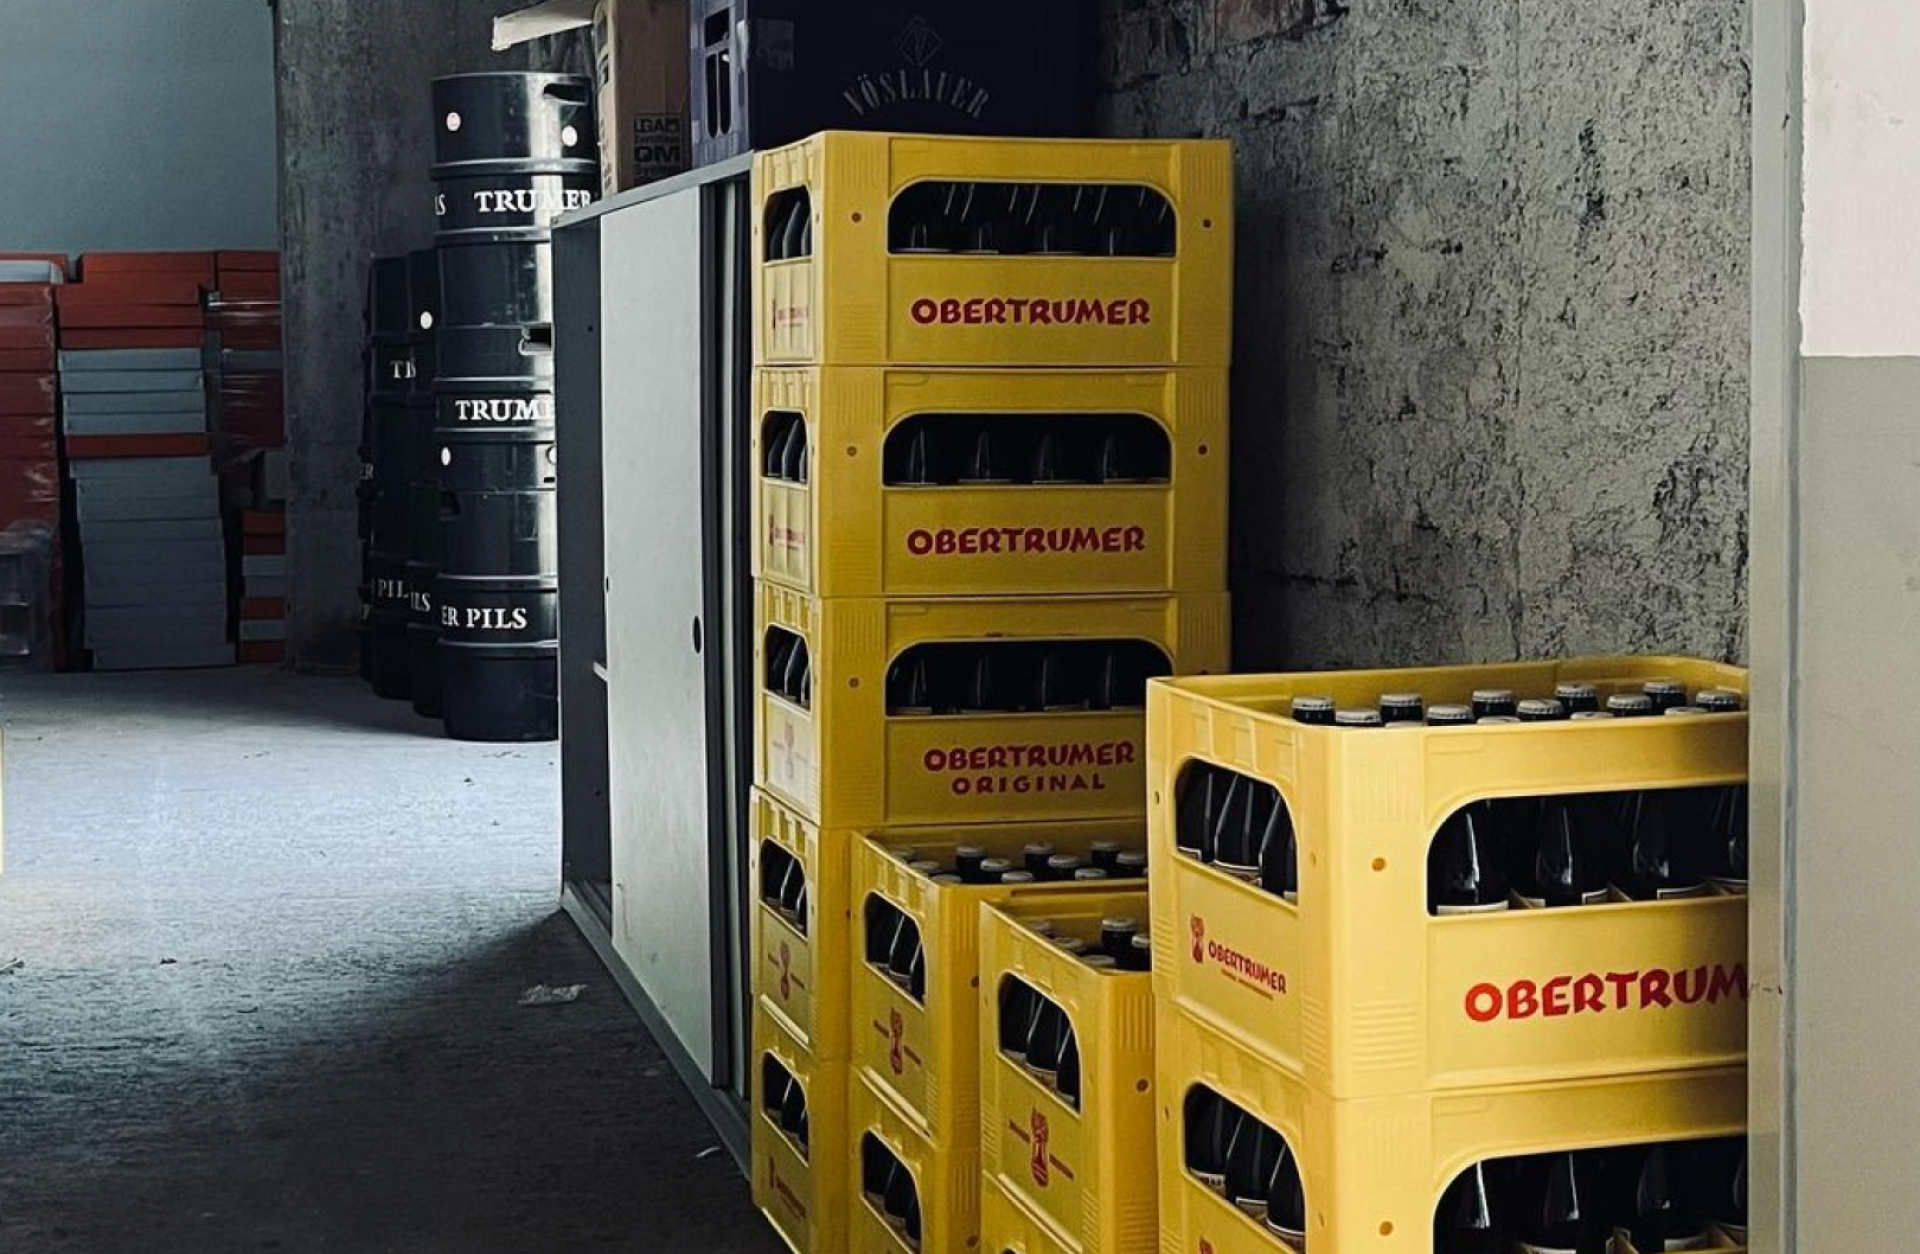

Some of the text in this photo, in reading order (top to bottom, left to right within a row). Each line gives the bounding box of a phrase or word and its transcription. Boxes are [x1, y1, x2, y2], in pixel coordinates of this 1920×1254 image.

[842, 67, 990, 118] VÖSLAUER
[911, 298, 1151, 324] OBERTRUMER
[907, 526, 1145, 555] OBERTRUMER
[466, 607, 528, 629] PILS
[924, 741, 1134, 772] OBERTRUMER
[952, 773, 1106, 795] ORIGINAL
[1208, 939, 1287, 995] OBERTRUMER
